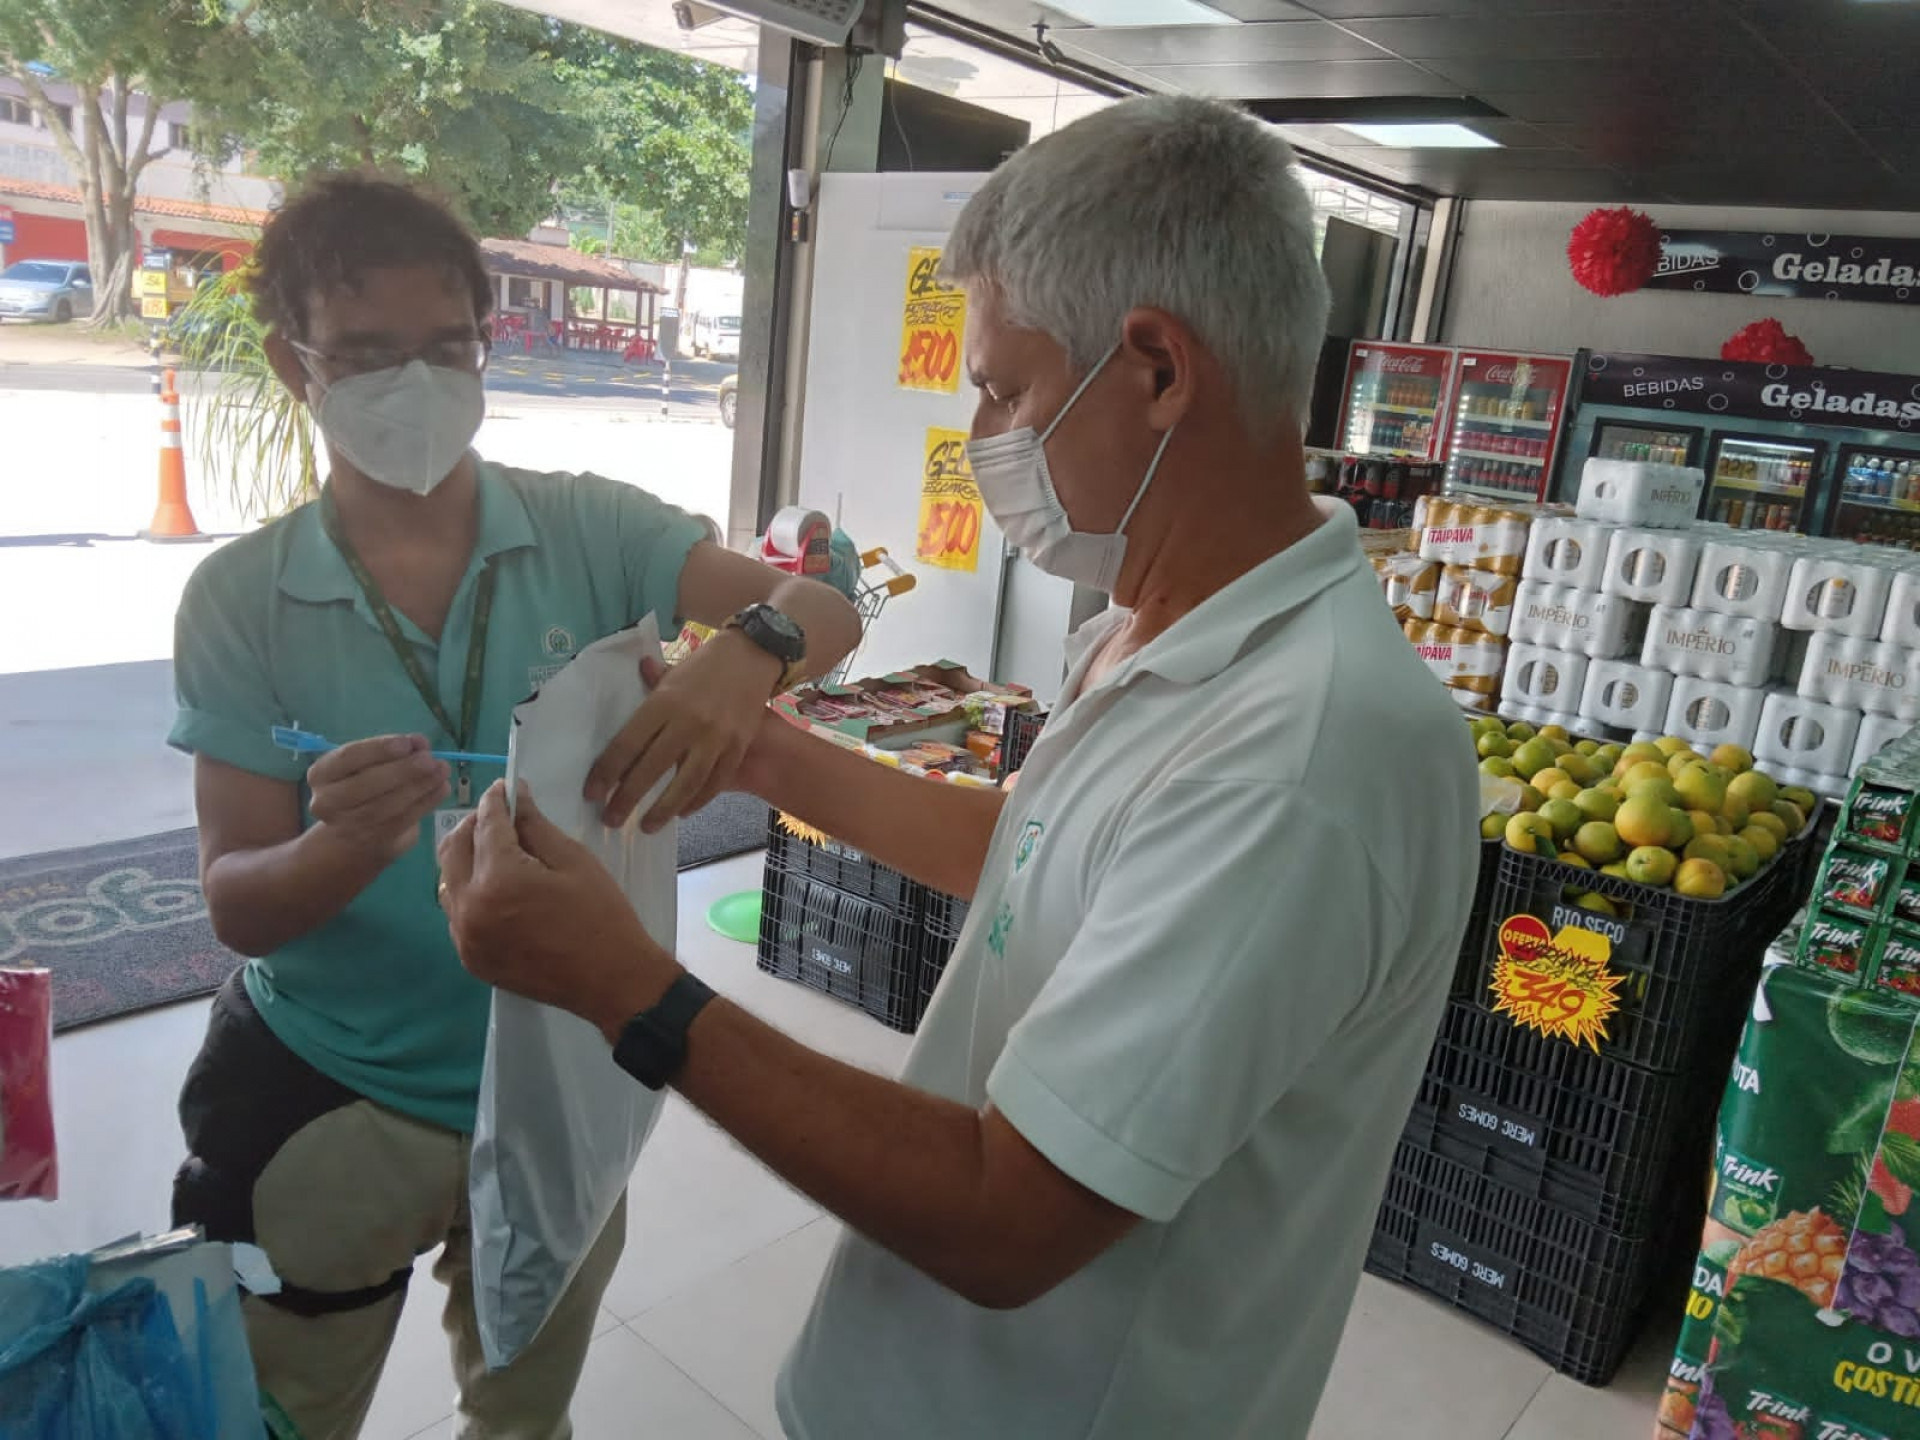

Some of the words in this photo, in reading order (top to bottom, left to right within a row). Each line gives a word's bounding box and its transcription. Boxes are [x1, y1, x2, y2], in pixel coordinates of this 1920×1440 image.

[1657, 252, 1719, 273] BIDAS
[1772, 252, 1920, 287] Gelada
[1623, 377, 1704, 397] BEBIDAS
[1761, 383, 1920, 420] Geladas
[1428, 527, 1474, 544] TAIPAVA
[1416, 646, 1452, 661] IPAVA
[1854, 792, 1907, 814] Trink
[1827, 857, 1880, 883] Trink
[1899, 887, 1920, 907] Tri
[1810, 922, 1863, 948] Trink
[1458, 1103, 1499, 1131] GOMES
[1501, 1120, 1537, 1148] MERC
[1723, 1154, 1779, 1192] Trink
[1430, 1241, 1469, 1272] GOMES
[1471, 1261, 1506, 1289] MERC
[1866, 1341, 1893, 1364] O
[1746, 1389, 1812, 1422] Trink
